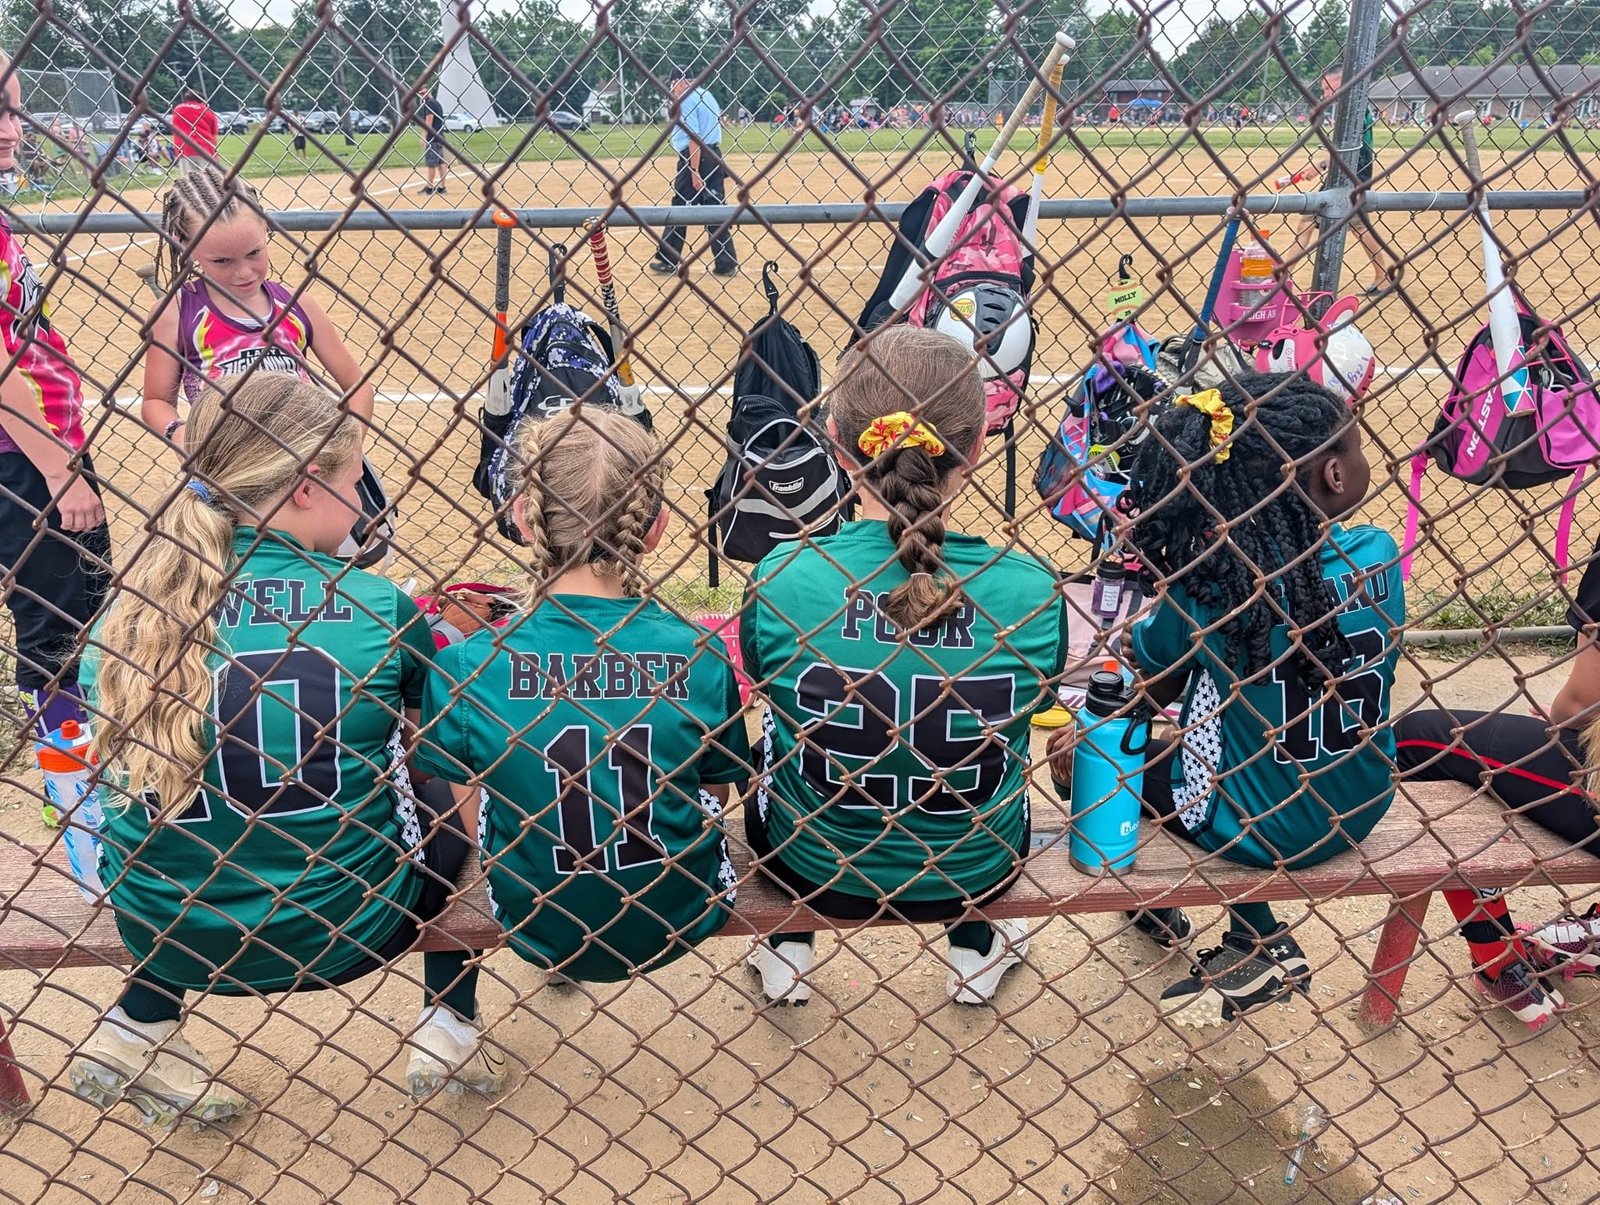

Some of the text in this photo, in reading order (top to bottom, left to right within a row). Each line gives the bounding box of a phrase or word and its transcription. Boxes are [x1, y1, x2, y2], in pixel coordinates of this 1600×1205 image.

[1114, 291, 1137, 305] MOLLY
[246, 348, 277, 358] LAY
[508, 652, 690, 700] BARBER
[794, 662, 1016, 815] 25
[544, 724, 669, 874] 11
